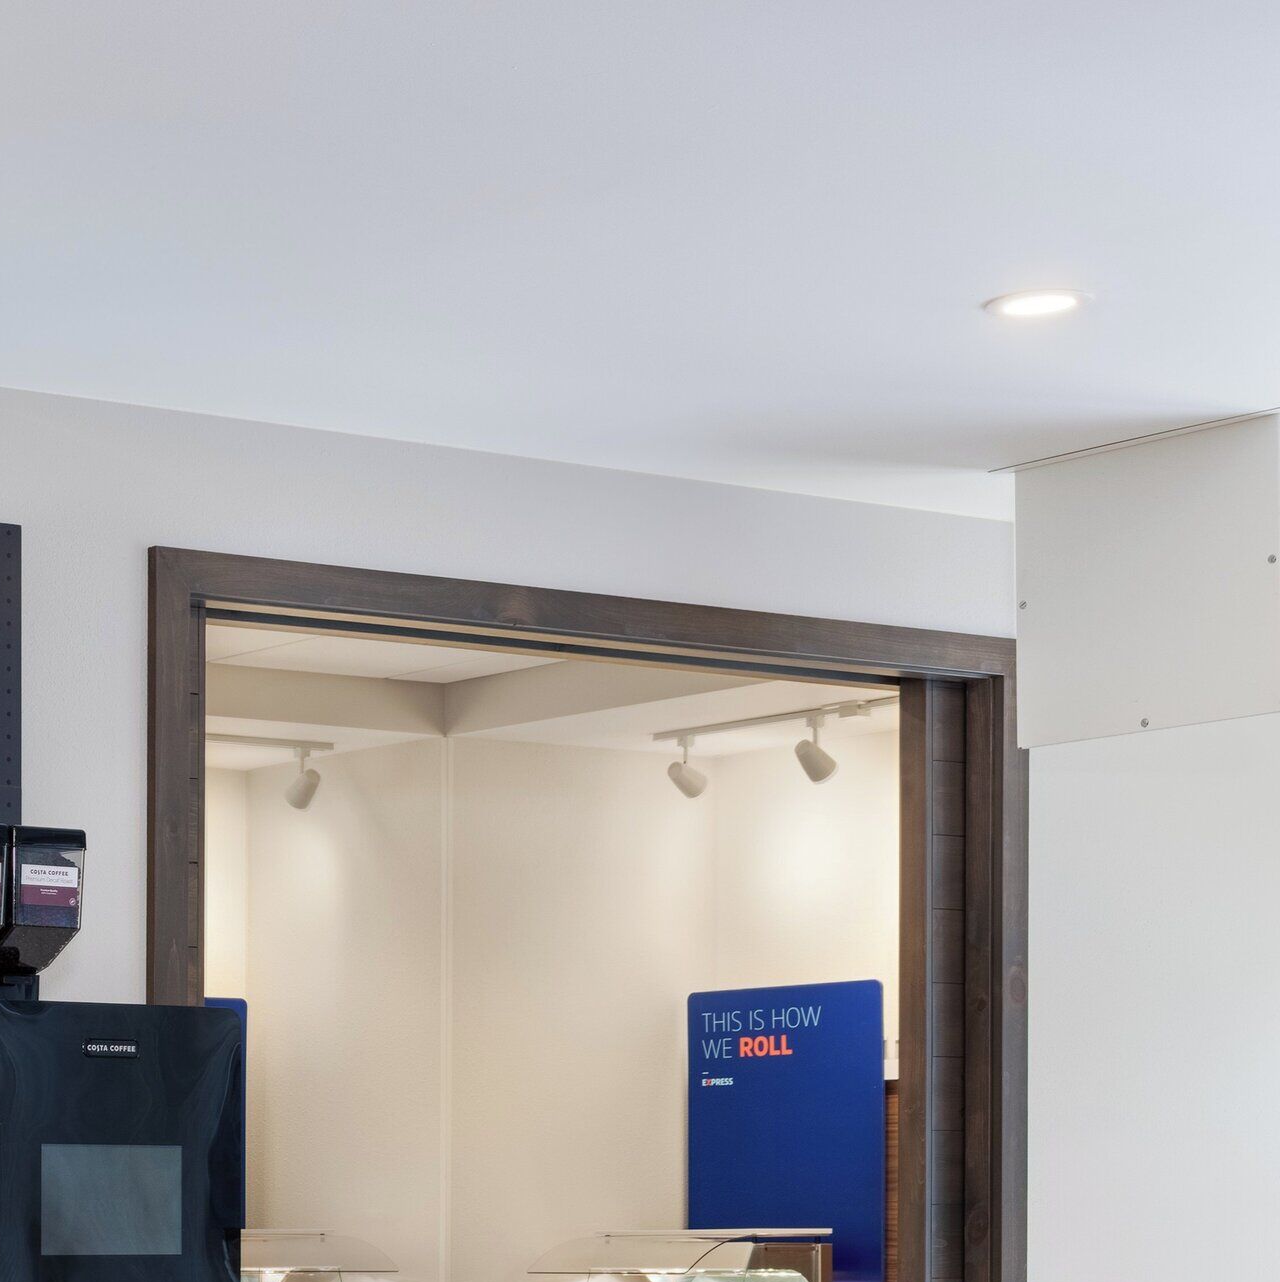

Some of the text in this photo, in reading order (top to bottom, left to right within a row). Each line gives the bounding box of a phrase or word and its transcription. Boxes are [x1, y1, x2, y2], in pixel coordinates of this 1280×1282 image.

[702, 1006, 822, 1033] THIS IS HOW
[702, 1035, 793, 1059] WE ROLL
[702, 1077, 734, 1087] EXPRESS
